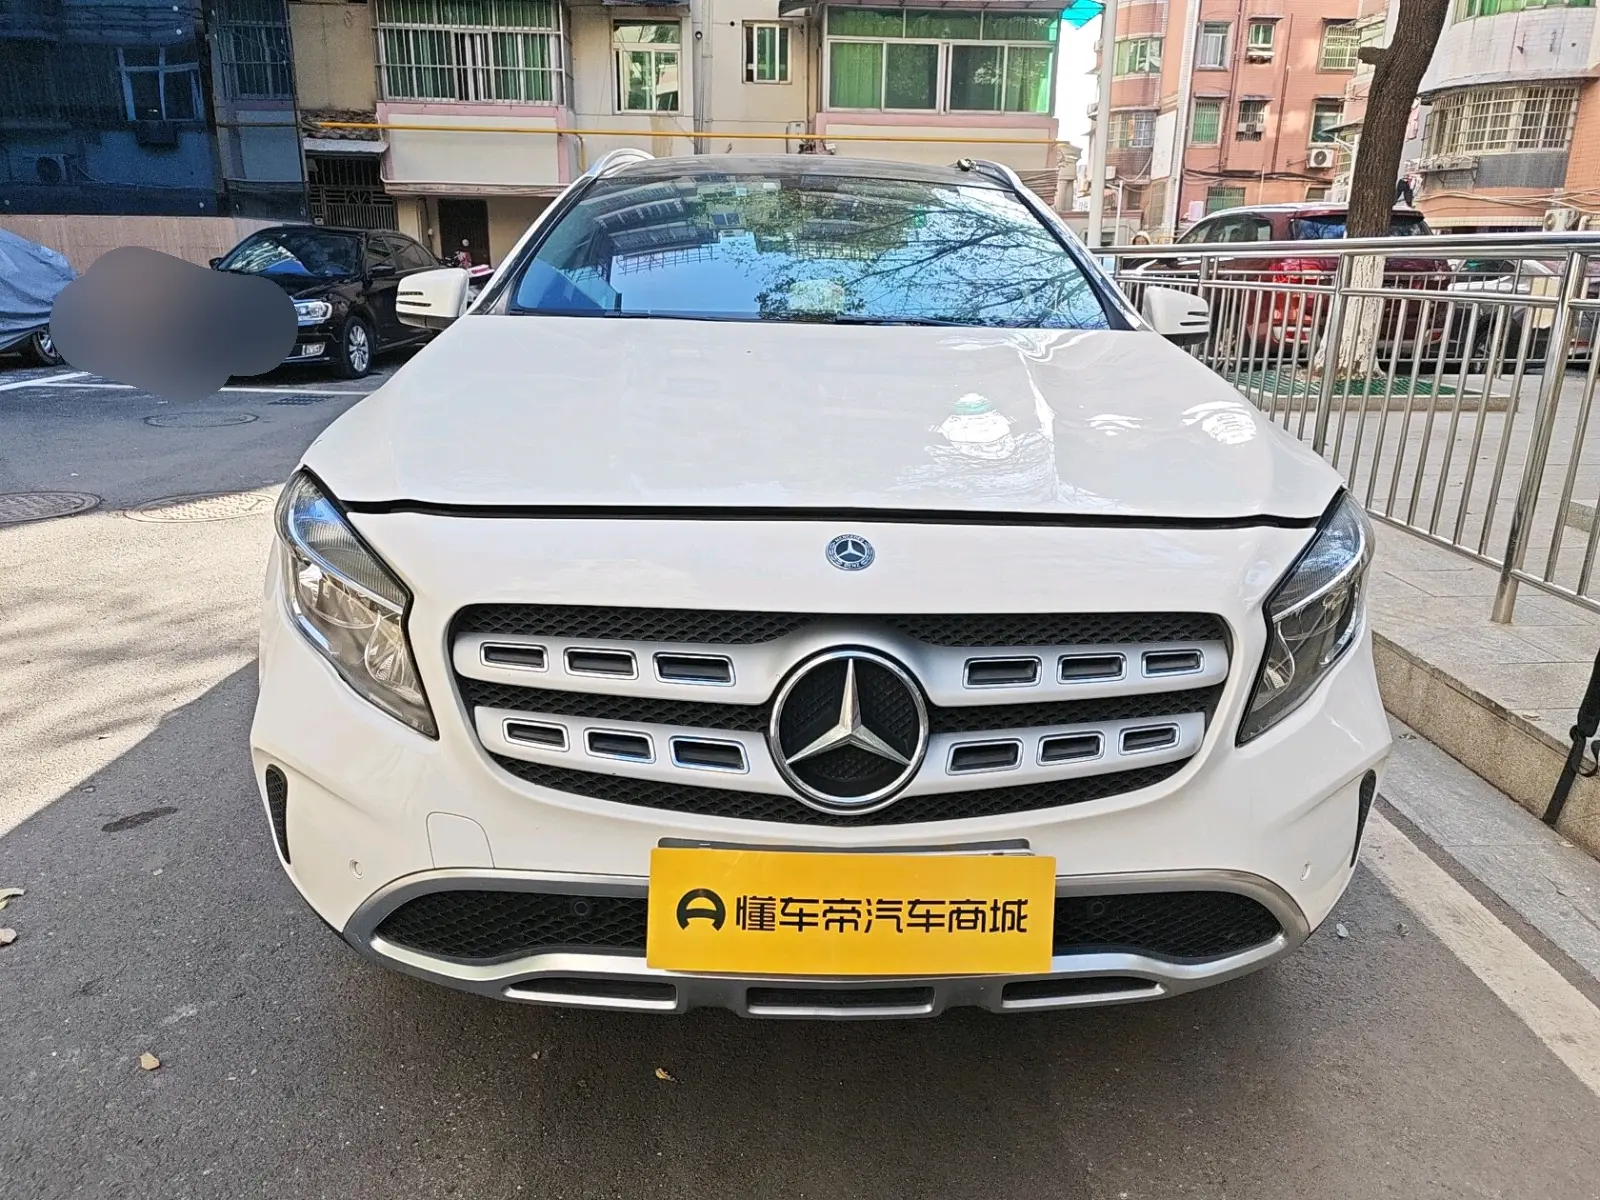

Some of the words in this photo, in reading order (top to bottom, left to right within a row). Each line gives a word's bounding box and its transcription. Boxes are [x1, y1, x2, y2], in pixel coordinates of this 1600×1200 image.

[736, 895, 1028, 934] 懂车帝汽车商城
